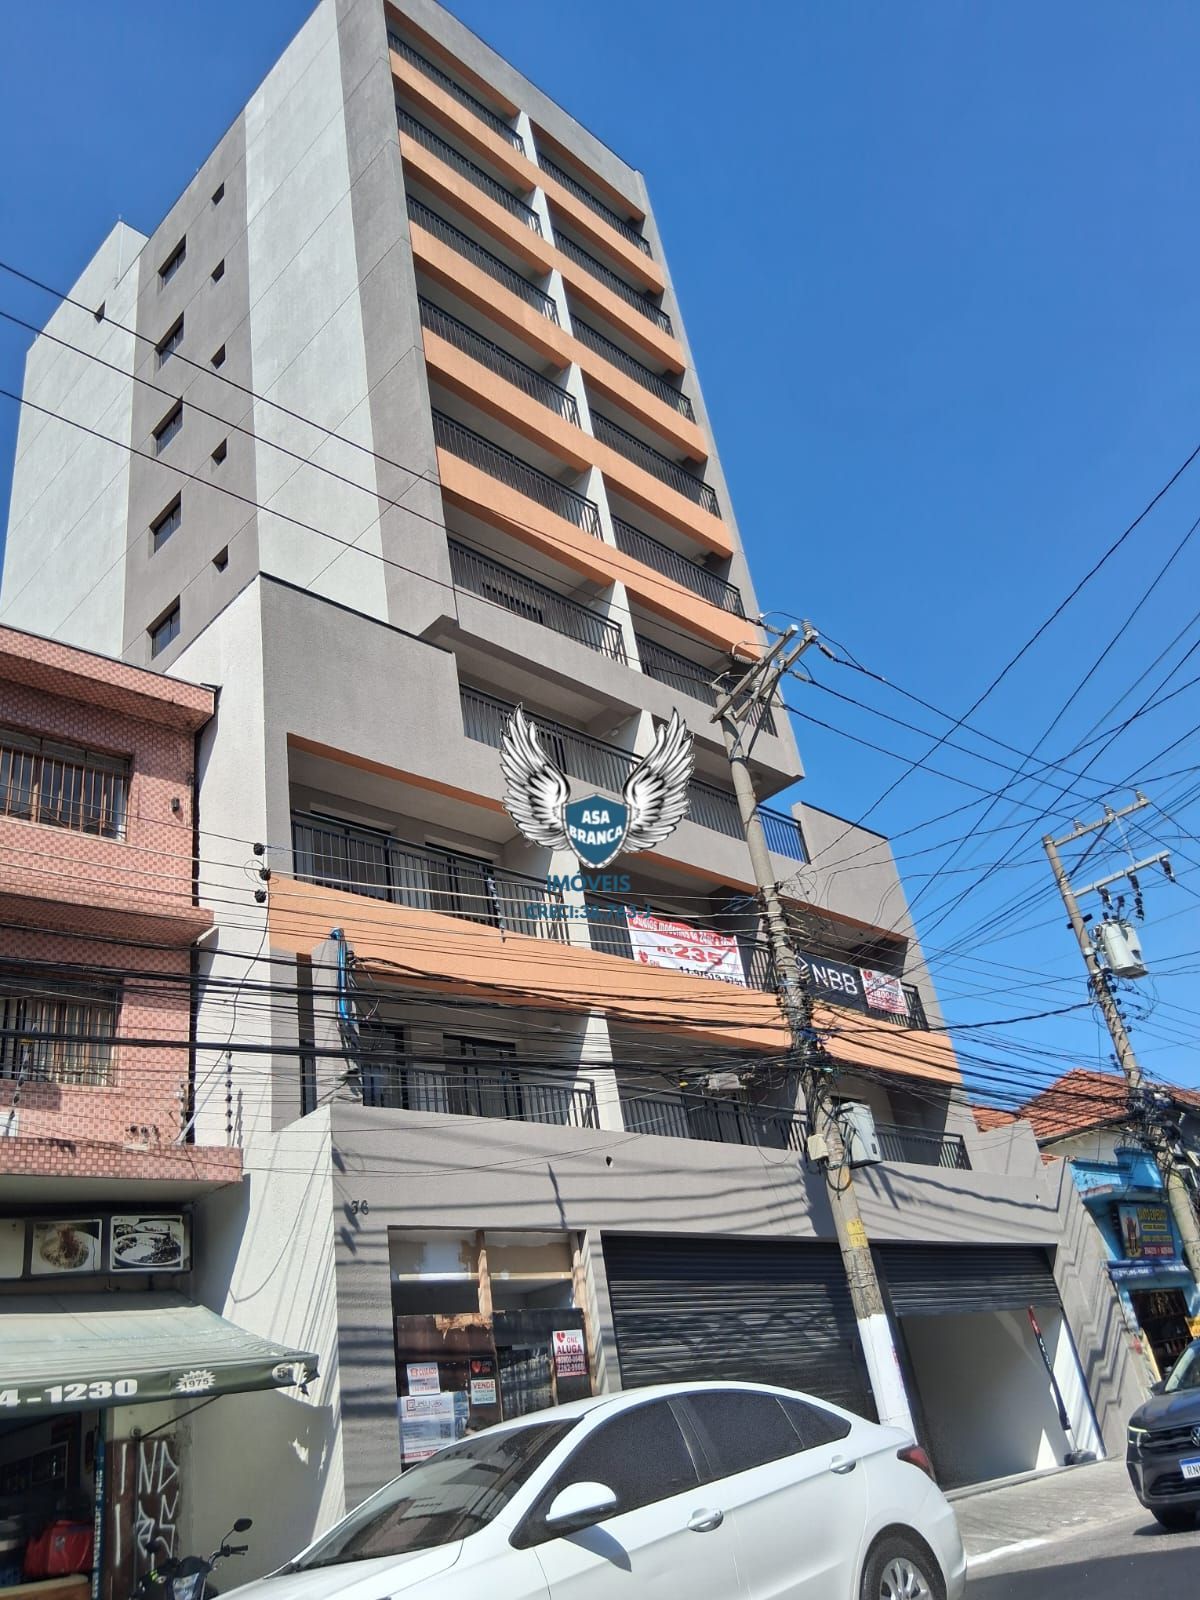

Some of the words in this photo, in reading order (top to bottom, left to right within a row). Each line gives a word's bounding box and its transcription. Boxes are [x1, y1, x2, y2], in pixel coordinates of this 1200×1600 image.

[673, 943, 722, 966] 235
[811, 963, 858, 995] NBB
[557, 1344, 582, 1355] ALUGA
[183, 1377, 209, 1389] 1975
[472, 1380, 495, 1390] VENDE
